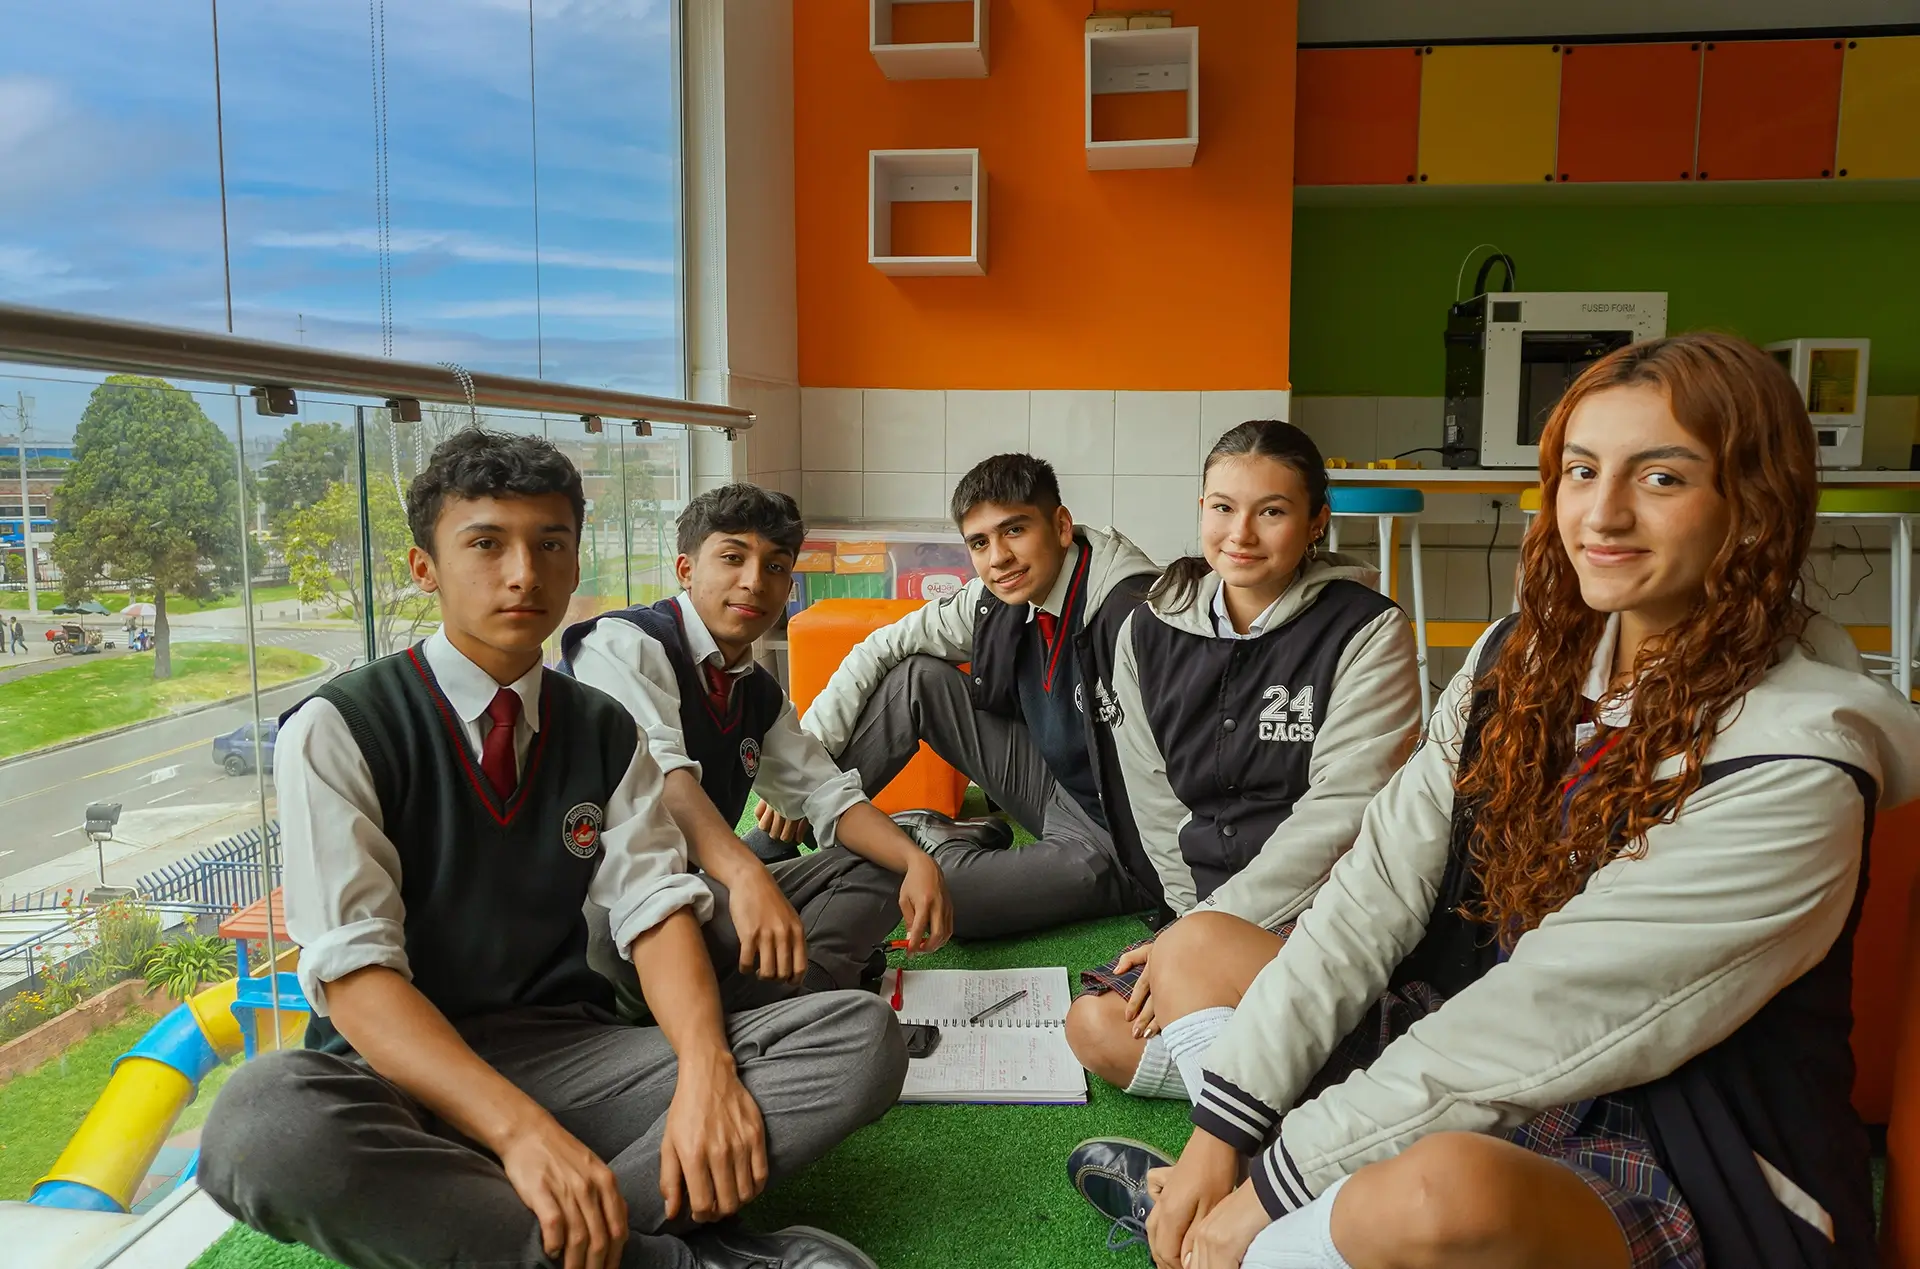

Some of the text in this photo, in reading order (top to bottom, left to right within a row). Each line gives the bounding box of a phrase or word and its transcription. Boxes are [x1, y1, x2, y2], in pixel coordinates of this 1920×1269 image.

[1582, 303, 1636, 313] FUSED FORM
[1259, 685, 1314, 722] 24
[1259, 721, 1315, 742] CACS
[567, 805, 601, 825] AGUSTINIANO
[565, 832, 584, 855] CIUDAD
